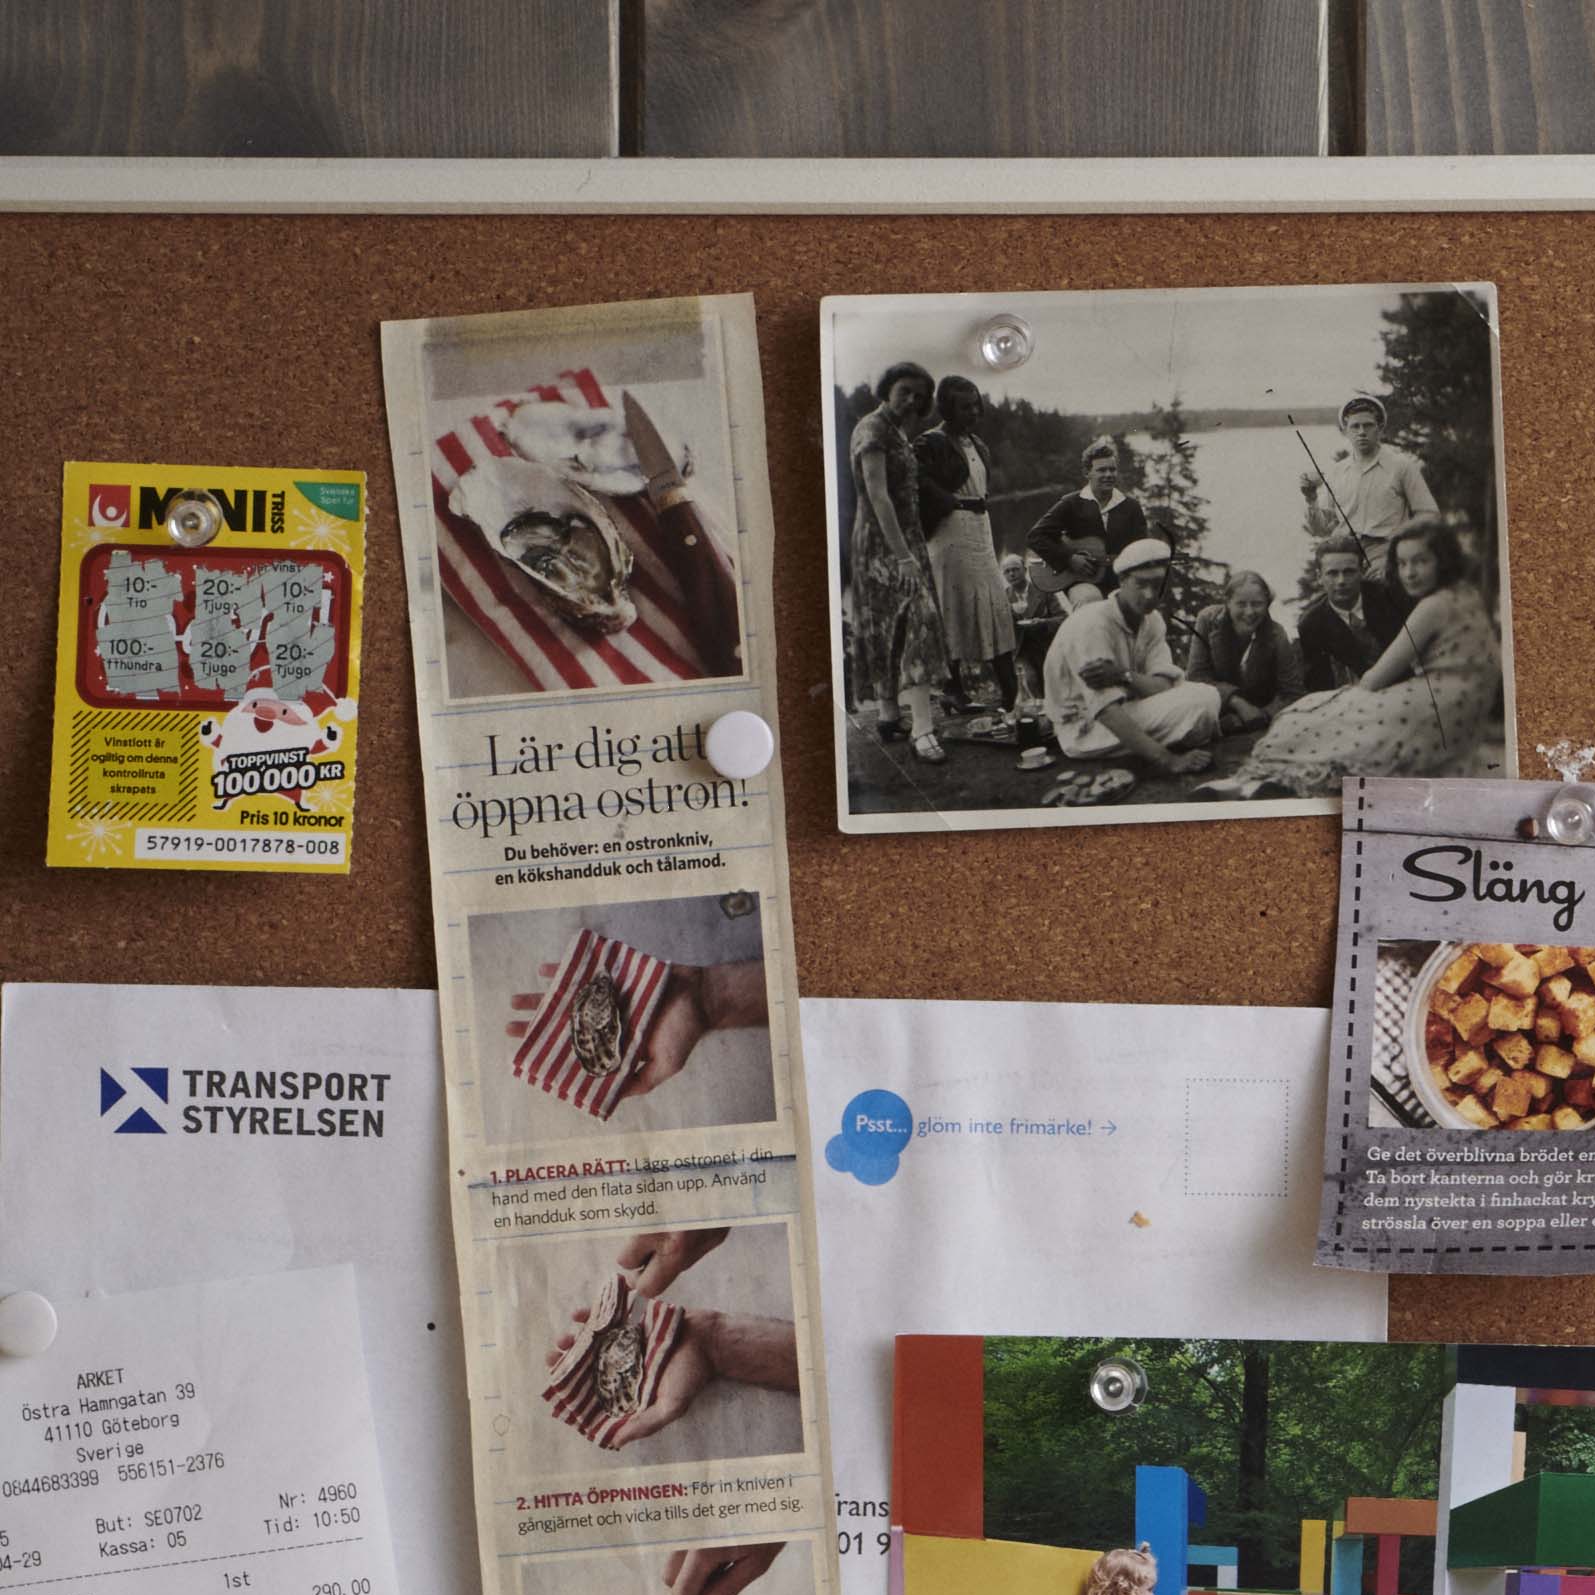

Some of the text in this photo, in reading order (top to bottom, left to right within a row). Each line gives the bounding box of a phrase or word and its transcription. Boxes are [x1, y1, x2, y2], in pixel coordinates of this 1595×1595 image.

[139, 487, 266, 532] MNI
[271, 491, 285, 534] TRISS
[127, 598, 147, 608] Tio
[284, 602, 304, 613] Tio
[202, 662, 237, 677] Tjugo
[276, 664, 311, 679] Tjugo
[105, 737, 165, 748] Vinstlott är
[485, 723, 707, 777] Lär dig att
[91, 753, 178, 765] ogiltig om denna
[229, 751, 307, 770] TOPPVINST
[103, 767, 165, 779] kontrollruta
[320, 764, 343, 779] KR
[110, 784, 156, 796] skrapats
[240, 811, 344, 827] Pris 10 kronor
[451, 777, 750, 839] öppna ostron!
[147, 835, 339, 855] 57919-0017878-008
[504, 831, 713, 862] Du behöver: en ostronkniv,
[495, 853, 726, 885] en kökshandduk och tålamod.
[1402, 844, 1585, 932] Släng
[183, 1069, 391, 1102] TRANSPORT
[182, 1105, 384, 1138] STYRELSEN
[856, 1115, 1092, 1138] Psst... glöm inte frimärke!
[1367, 1146, 1392, 1163] Ge
[1395, 1145, 1423, 1162] det
[1426, 1147, 1515, 1163] överblivna
[1519, 1147, 1574, 1163] brödet
[490, 1157, 630, 1185] 1. PLACERA RÄTT:
[1366, 1170, 1387, 1184] Ta
[1390, 1169, 1426, 1185] bort
[1430, 1169, 1505, 1185] kanterna
[1508, 1168, 1540, 1185] och
[1544, 1168, 1573, 1189] gör
[1361, 1214, 1426, 1230] strössla
[1431, 1216, 1468, 1230] över
[1472, 1217, 1492, 1230] en
[1497, 1216, 1546, 1233] soppa
[1550, 1213, 1588, 1228] eller
[76, 1368, 125, 1391] ARKET
[22, 1383, 196, 1422] Östra Hamngatan 39
[44, 1412, 180, 1443] 41110 Göteborg
[76, 1442, 144, 1463] Sverige
[117, 1452, 225, 1482] 556151-2376
[278, 1483, 358, 1509] Nr: 4960
[516, 1496, 531, 1510] 2.
[534, 1491, 584, 1510] HITTA
[586, 1483, 688, 1505] ÖPPNINGEN:
[691, 1481, 715, 1496] För
[719, 1479, 733, 1493] in
[737, 1475, 784, 1492] kniven
[835, 1493, 889, 1517] rans
[95, 1504, 203, 1535] But: SE0702
[264, 1507, 361, 1536] Tid: 10:50
